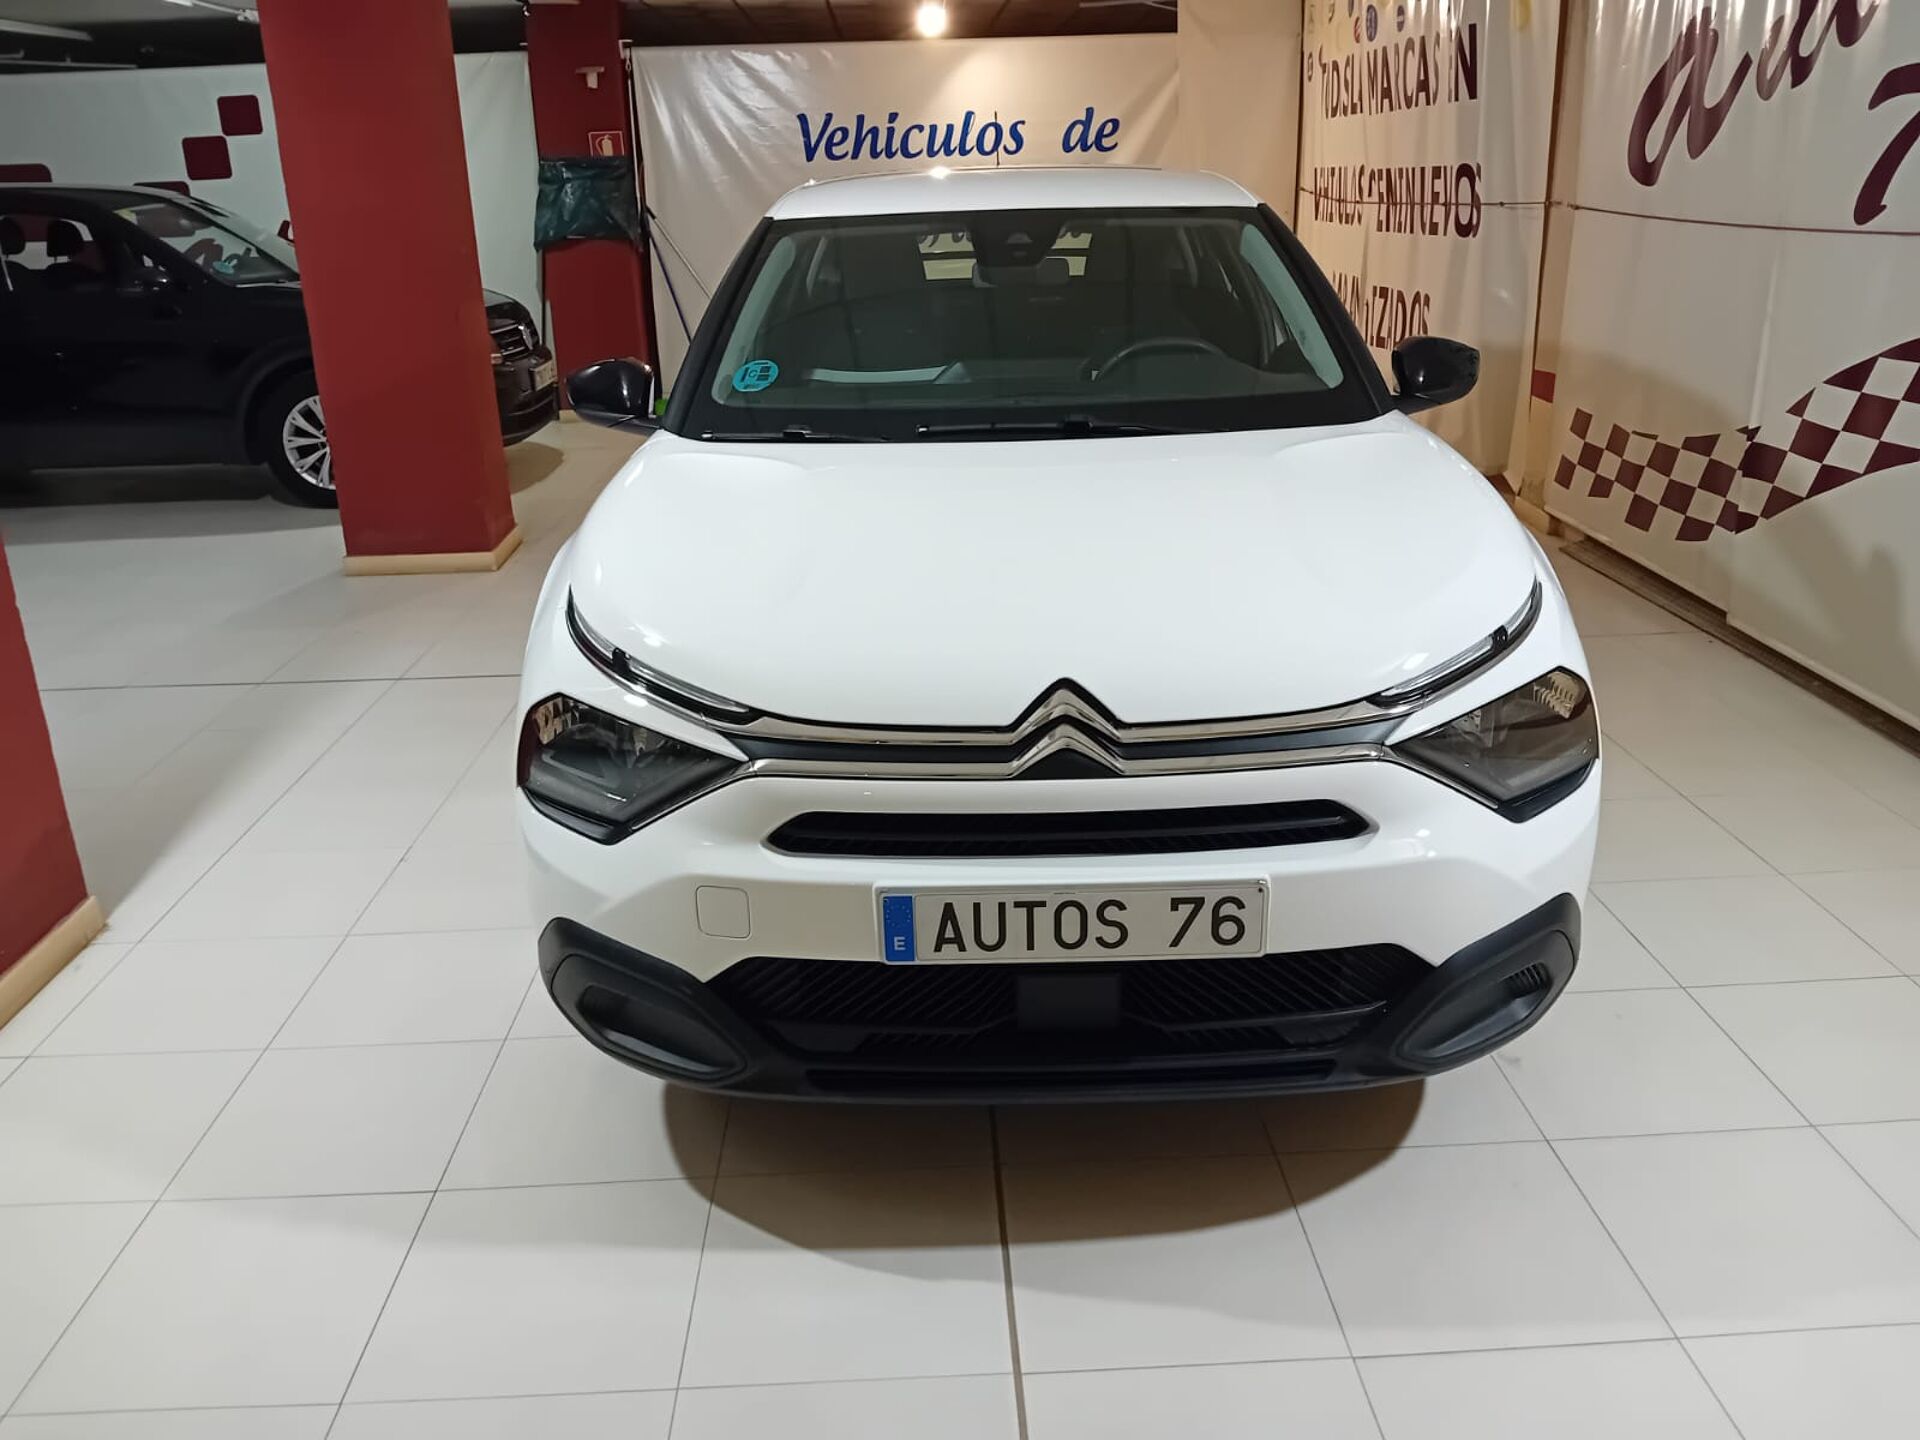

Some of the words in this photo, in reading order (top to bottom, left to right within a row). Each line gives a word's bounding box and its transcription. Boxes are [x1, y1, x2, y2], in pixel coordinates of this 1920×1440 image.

[1061, 107, 1120, 153] de
[893, 936, 906, 951] E
[933, 899, 1129, 953] AUTOS
[1168, 896, 1246, 948] 76
